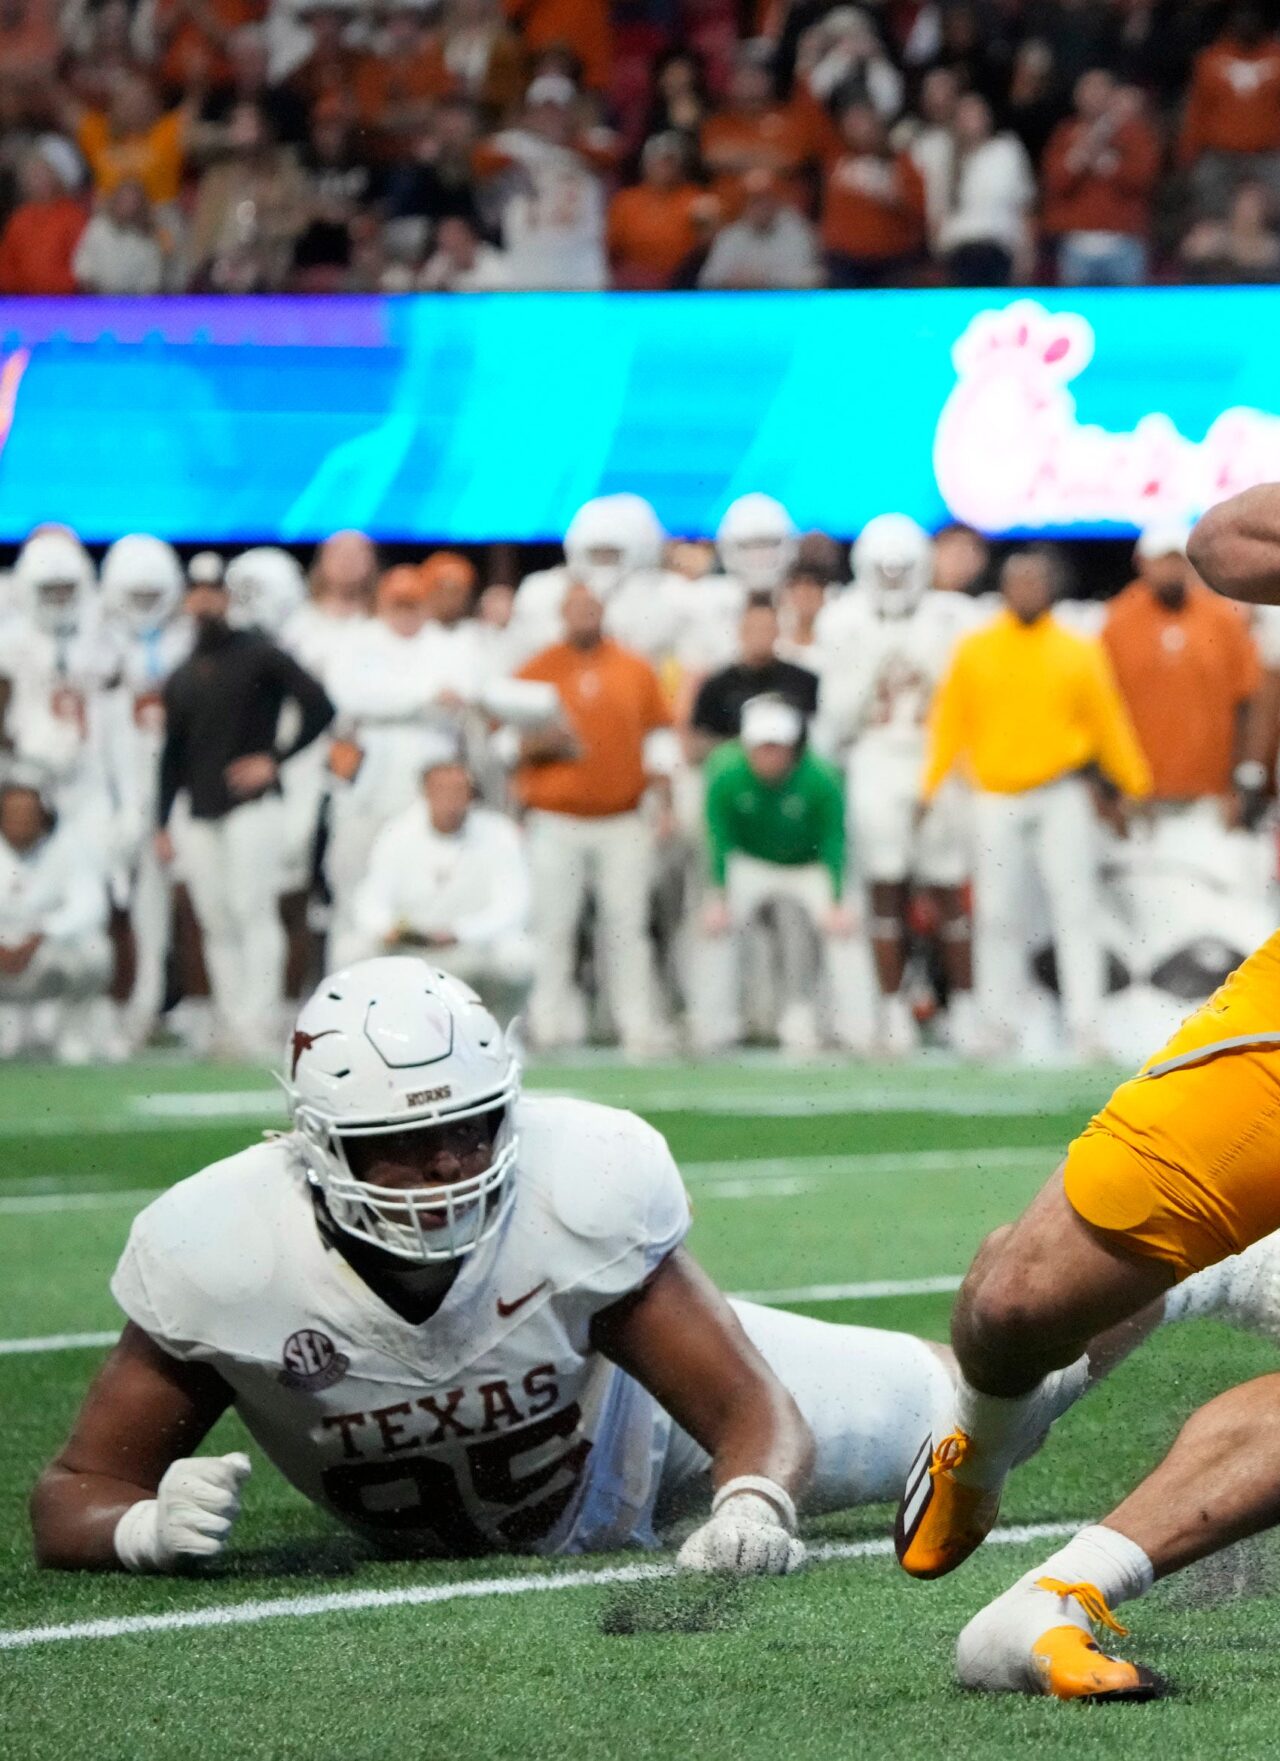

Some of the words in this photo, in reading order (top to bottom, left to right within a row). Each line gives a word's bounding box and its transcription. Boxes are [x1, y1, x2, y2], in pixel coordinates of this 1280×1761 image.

[406, 1084, 452, 1107] HORNS
[284, 1331, 334, 1375] SEC
[321, 1364, 560, 1459] TEXAS
